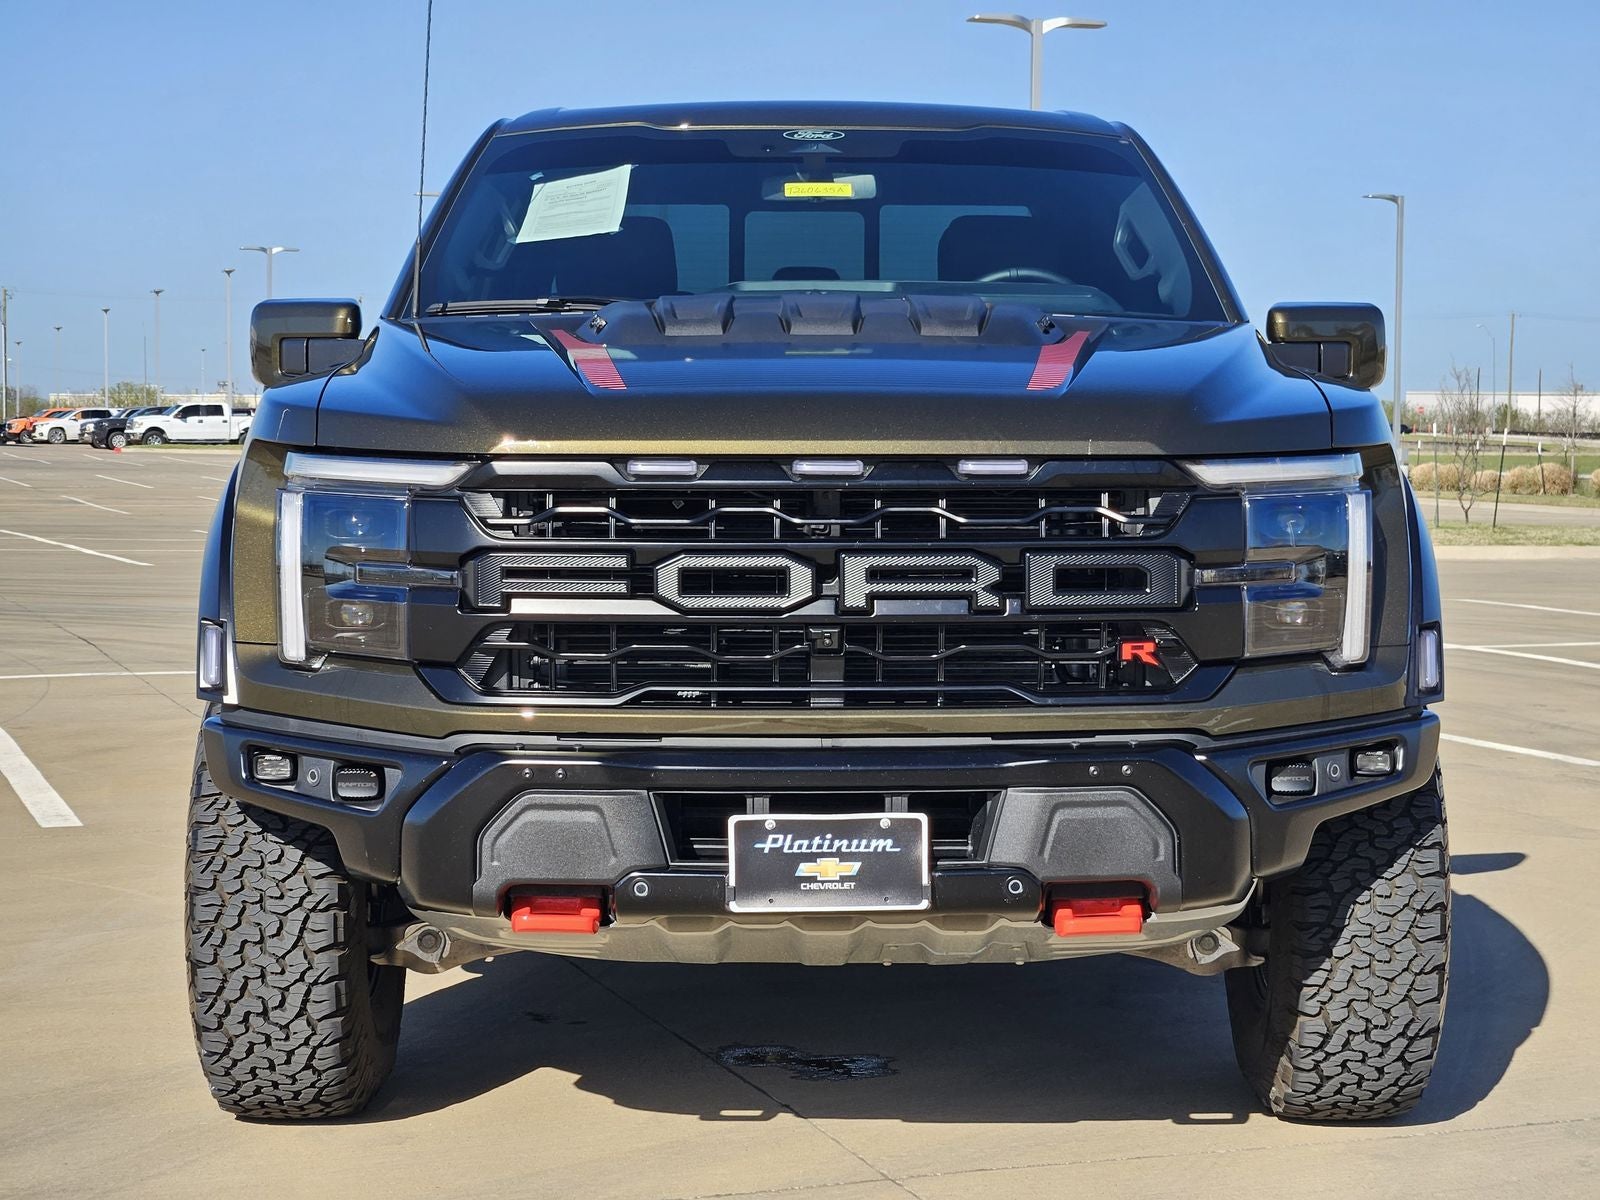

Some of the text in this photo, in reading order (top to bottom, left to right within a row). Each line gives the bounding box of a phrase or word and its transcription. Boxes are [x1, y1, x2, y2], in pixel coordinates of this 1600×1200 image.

[794, 130, 833, 139] Ford
[472, 551, 1186, 611] FORD
[1121, 642, 1159, 666] R
[753, 833, 901, 854] Platinum
[800, 882, 856, 890] CHEVROLET
